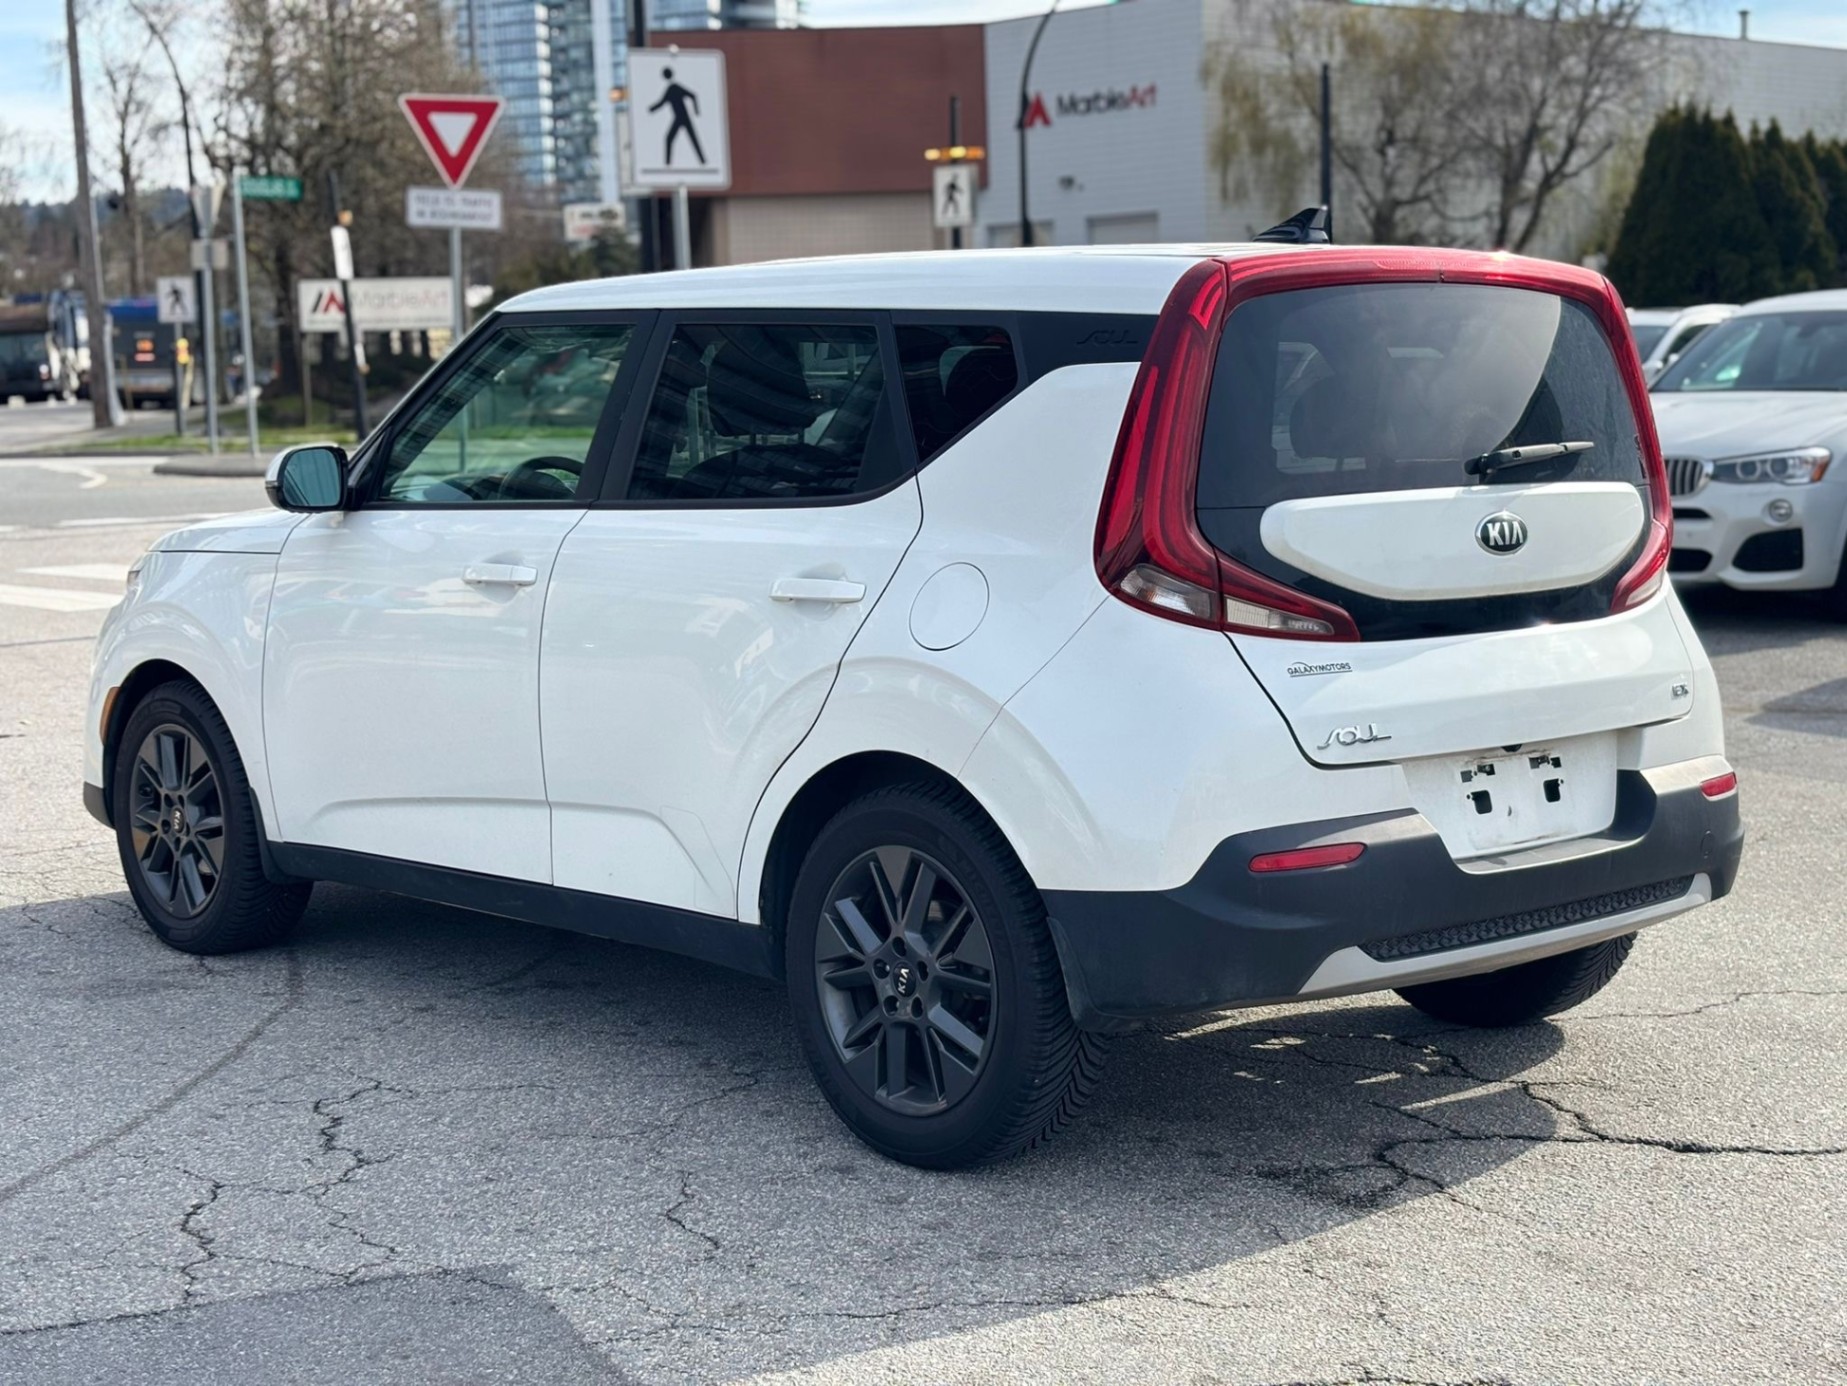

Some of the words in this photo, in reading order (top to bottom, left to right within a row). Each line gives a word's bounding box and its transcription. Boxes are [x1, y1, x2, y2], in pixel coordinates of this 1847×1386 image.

[1056, 83, 1157, 115] MarbleArt
[1486, 521, 1524, 546] KIA
[1286, 662, 1351, 675] GALAXYMOTORS
[1317, 723, 1393, 750] SOUL
[897, 968, 910, 994] KIA
